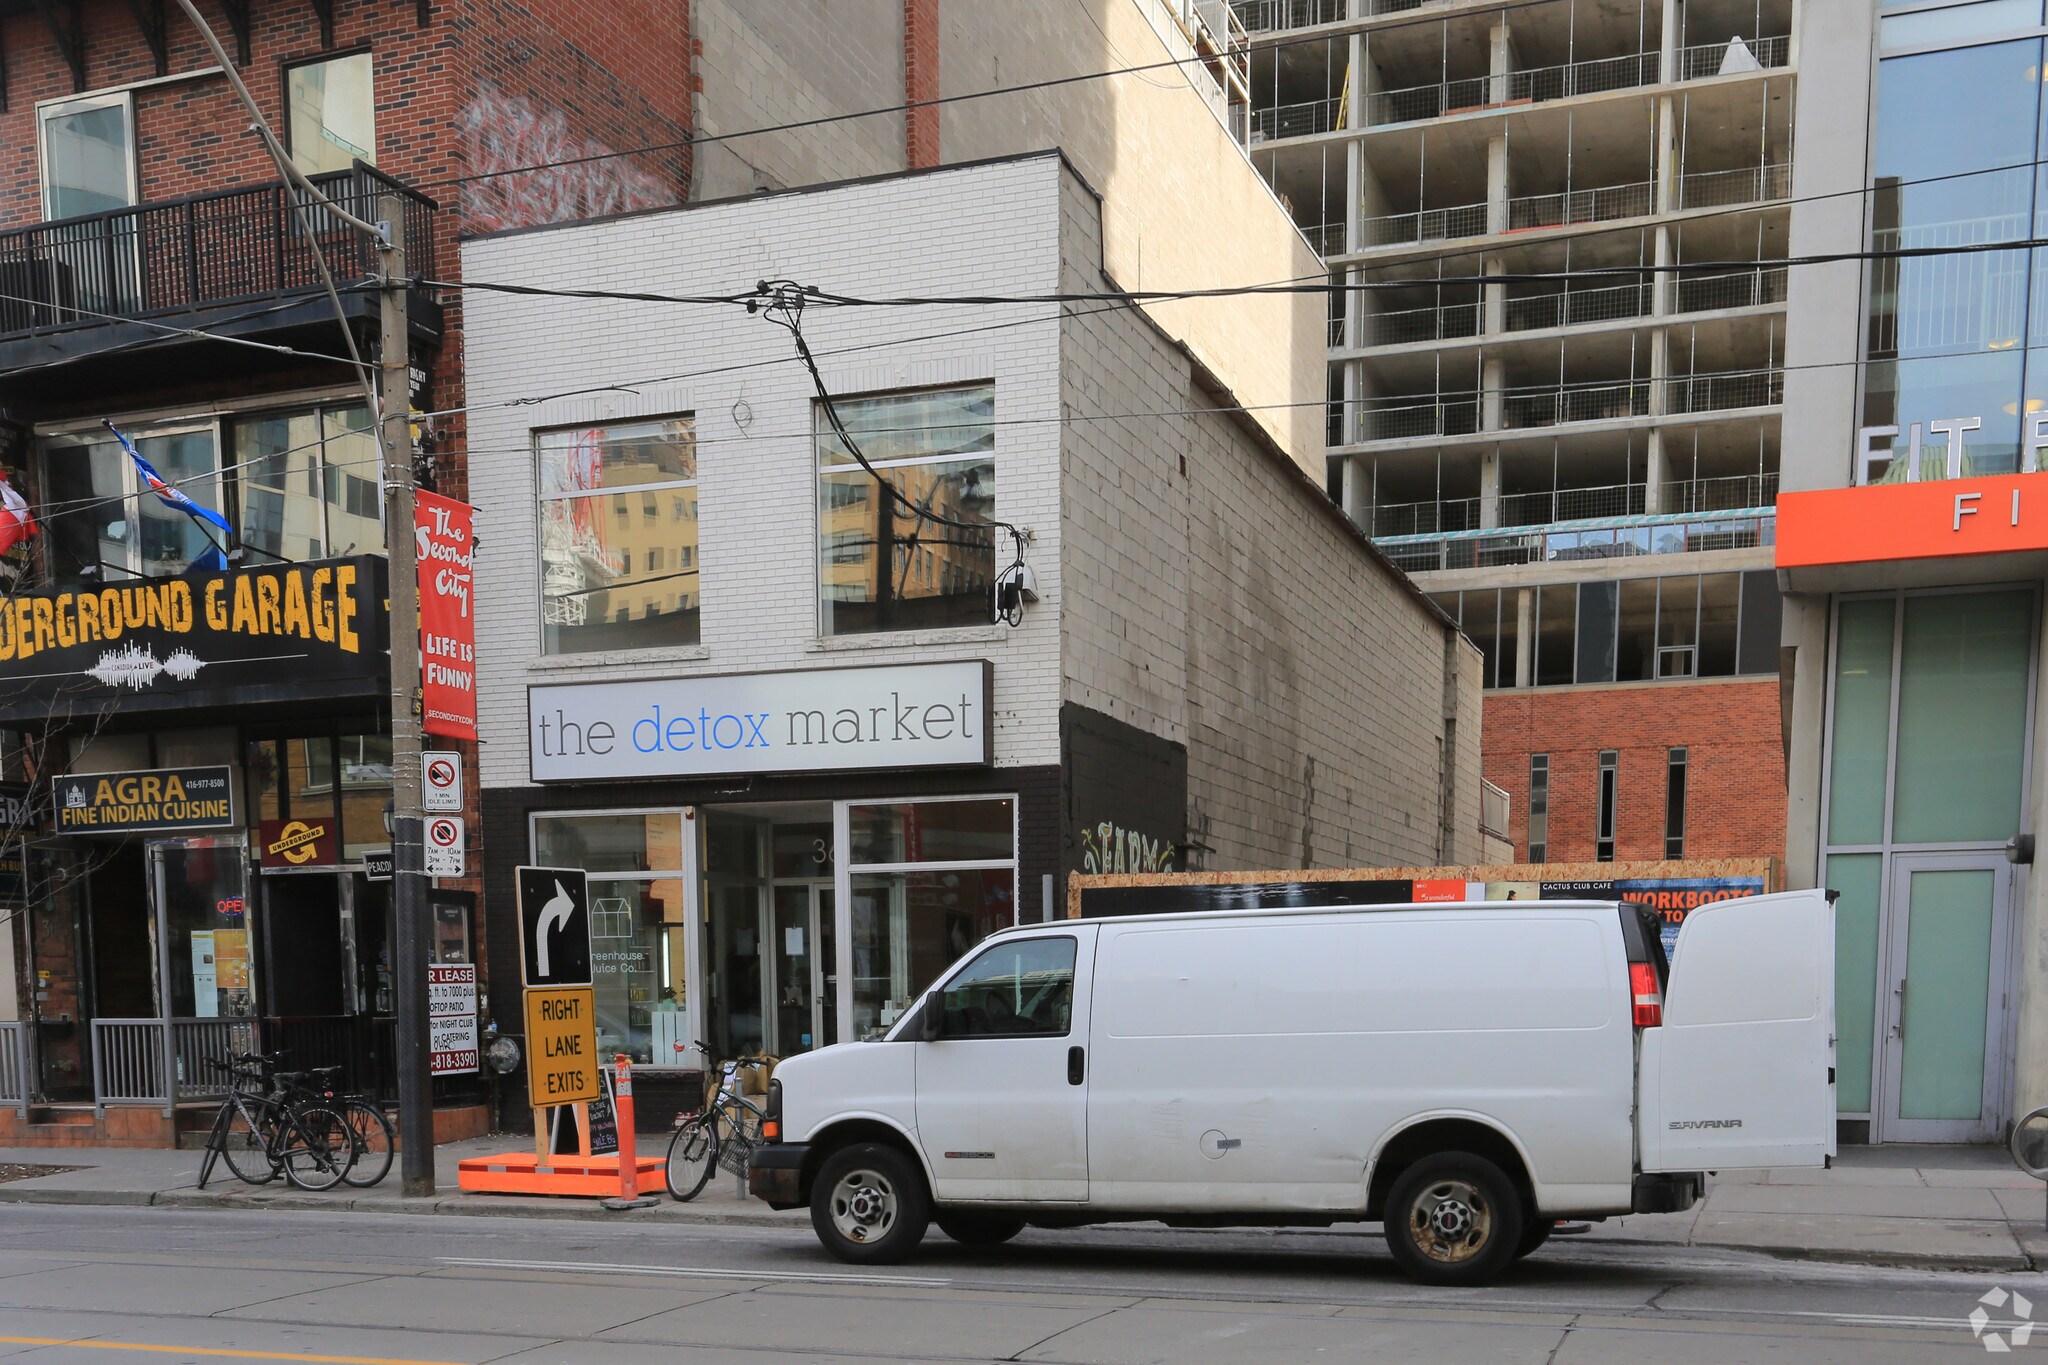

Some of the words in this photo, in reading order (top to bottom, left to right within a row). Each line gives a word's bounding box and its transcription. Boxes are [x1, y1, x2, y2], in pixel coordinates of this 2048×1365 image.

[1856, 417, 1981, 487] FIT
[1953, 489, 2020, 531] FI
[428, 507, 465, 542] The
[416, 525, 473, 571] Second
[435, 568, 471, 618] City
[205, 565, 359, 654] GARAGE
[427, 633, 457, 659] LIFE
[460, 643, 473, 663] IS
[427, 662, 472, 692] FUNNY
[428, 709, 473, 725] SECONDCITY.COM
[539, 709, 616, 757] the
[632, 705, 770, 752] detox
[786, 692, 973, 745] market
[94, 775, 187, 806] AGRA
[186, 779, 225, 789] 416-977-8500
[62, 806, 98, 826] FINE
[102, 803, 159, 824] INDIAN
[163, 800, 229, 820] CUISINE
[272, 829, 321, 851] UNDERGROUND
[1664, 910, 1683, 923] TO
[591, 951, 643, 961] reenhouse
[440, 970, 473, 981] LEASE
[620, 963, 637, 973] Co.
[442, 987, 448, 997] to
[449, 986, 462, 997] 7000
[449, 1002, 464, 1011] PATIO
[542, 998, 580, 1021] RIGHT
[440, 1020, 457, 1029] NIGHT
[459, 1019, 474, 1028] CLUB
[441, 1032, 470, 1043] CATERING
[545, 1034, 582, 1057] LANE
[431, 1052, 475, 1069] -818-3390
[547, 1070, 584, 1094] EXITS
[1669, 1119, 1742, 1129] SAVANA
